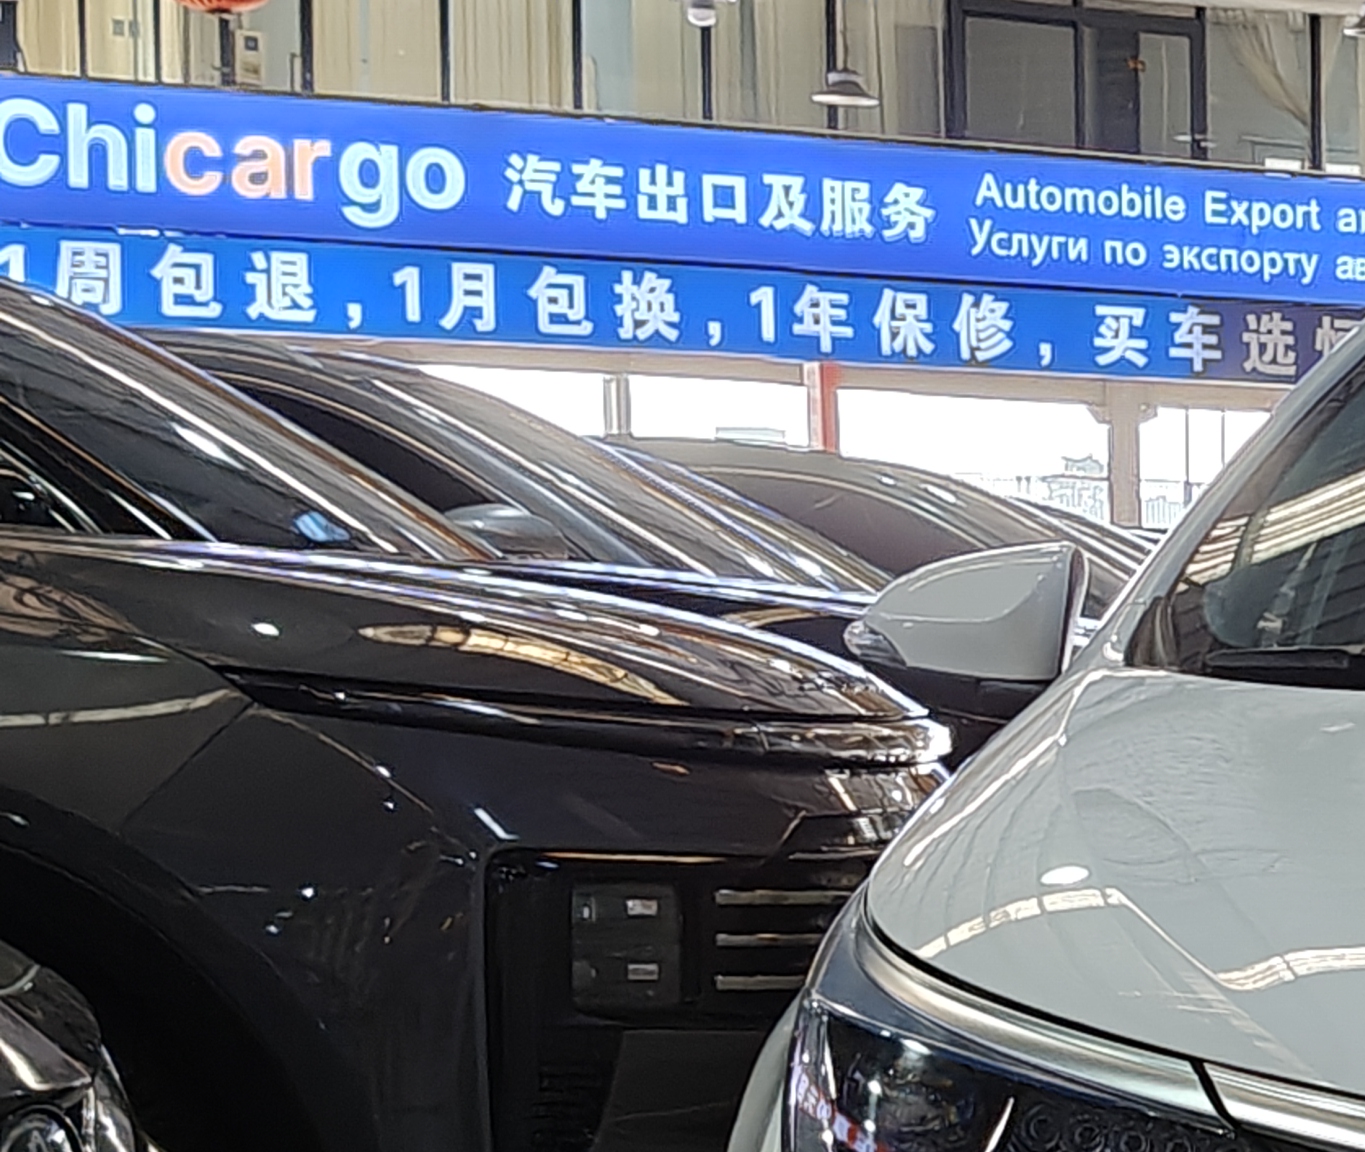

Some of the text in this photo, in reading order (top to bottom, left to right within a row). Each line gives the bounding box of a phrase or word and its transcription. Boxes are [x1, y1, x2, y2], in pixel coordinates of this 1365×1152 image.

[0, 98, 466, 228] Chicargo
[505, 152, 936, 242] 汽车出口及服务
[975, 172, 1186, 222] Automobile
[1203, 190, 1322, 235] Export
[968, 216, 1089, 267] Услуги
[1104, 240, 1148, 267] по
[1162, 243, 1319, 285] экспорту
